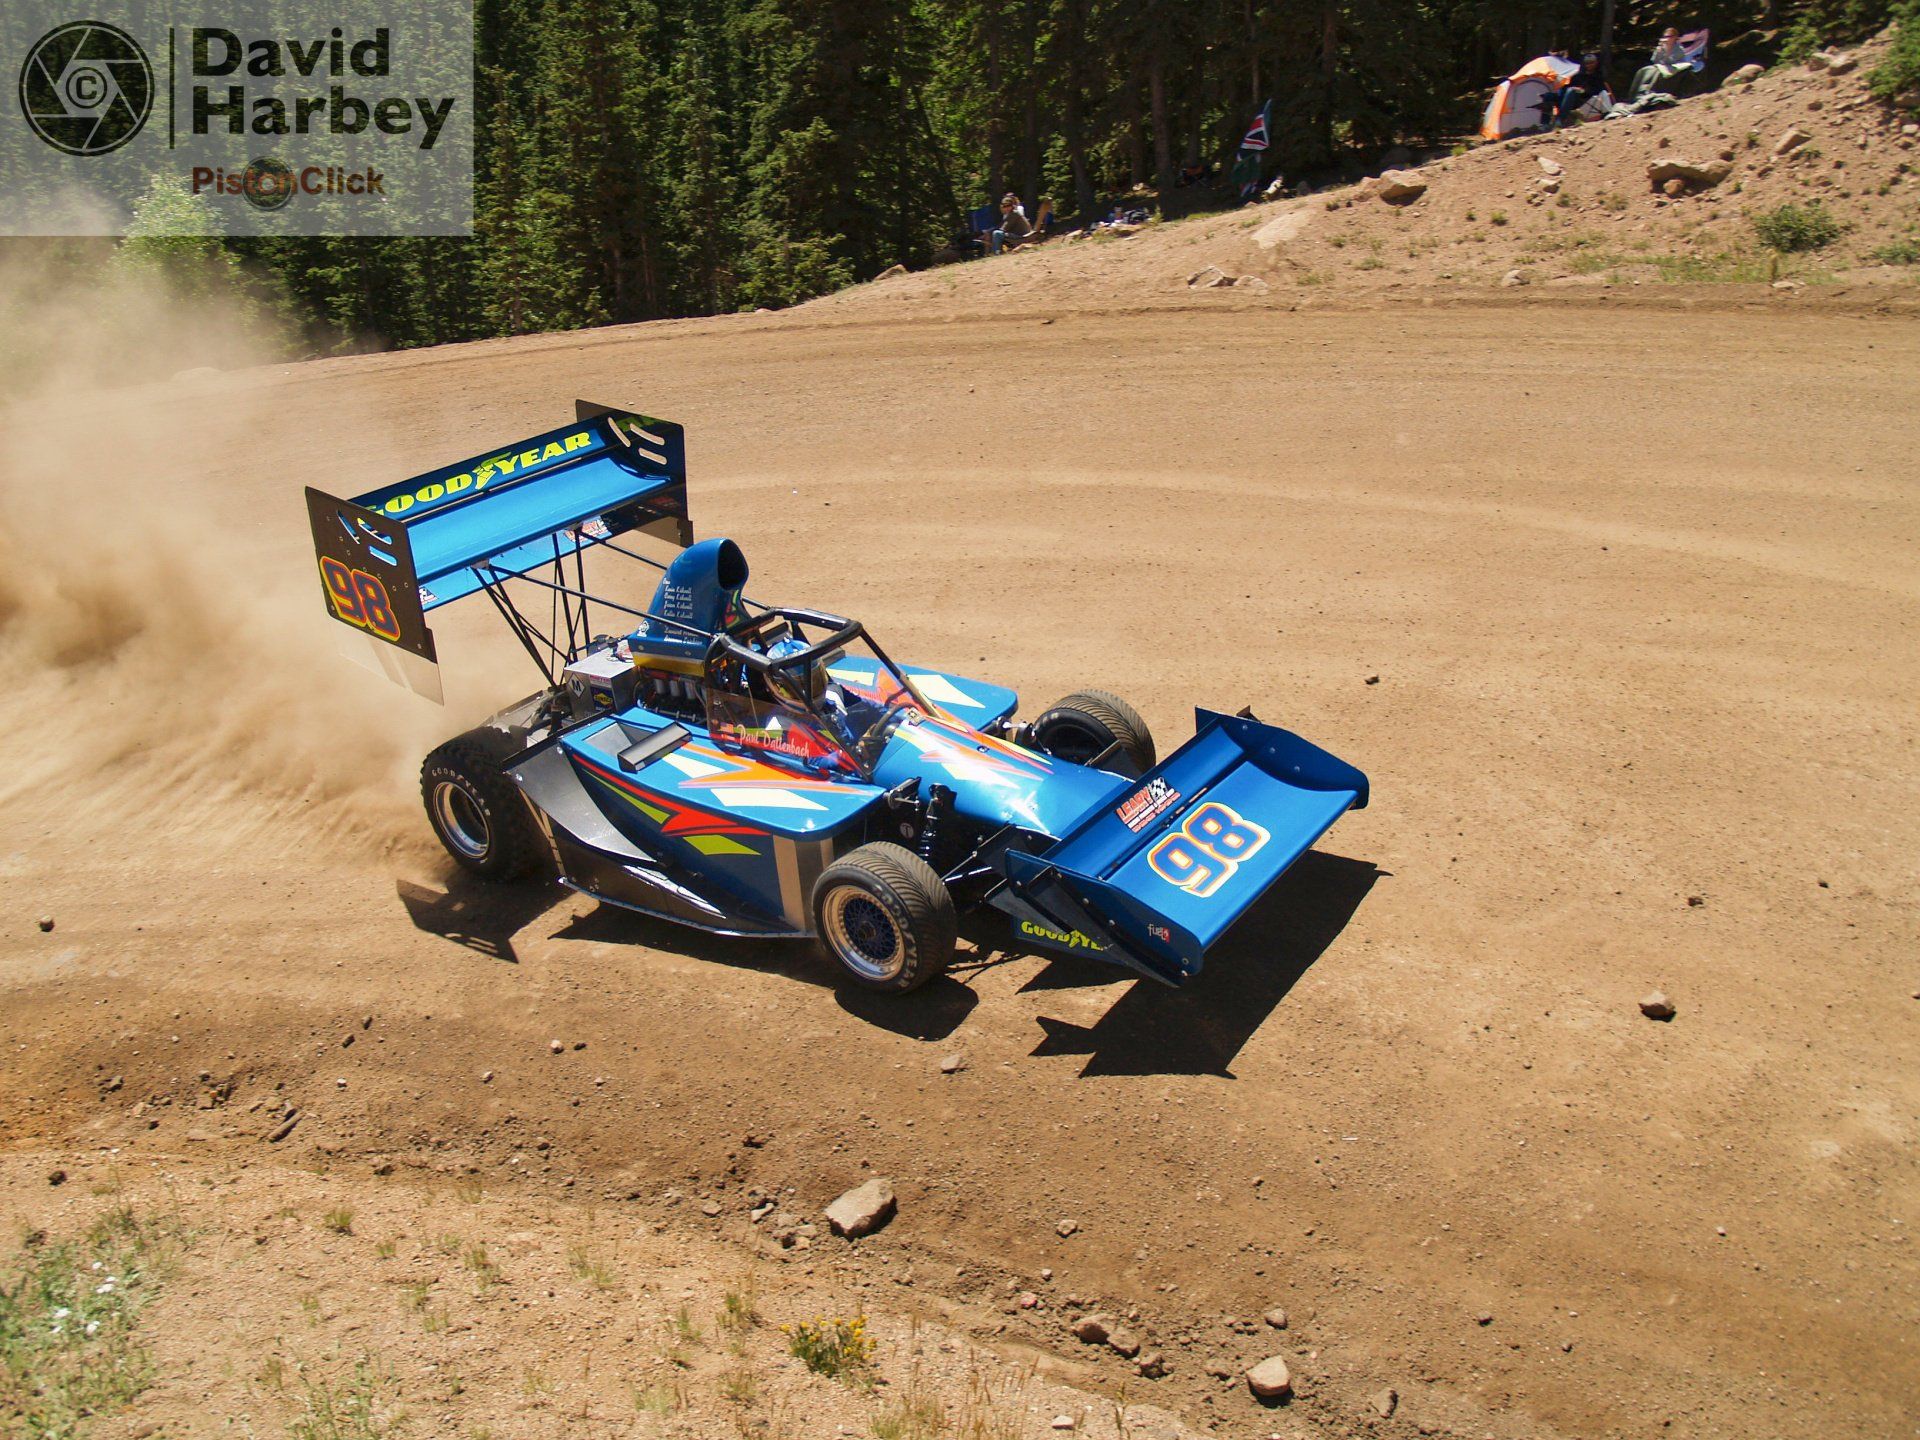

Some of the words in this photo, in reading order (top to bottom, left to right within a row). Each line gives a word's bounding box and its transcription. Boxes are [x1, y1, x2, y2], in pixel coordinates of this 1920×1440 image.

[320, 555, 401, 642] 98
[736, 723, 760, 746] Paul
[761, 730, 810, 758] Dallenbach
[1116, 786, 1153, 821] LEARY
[1147, 802, 1271, 898] 98
